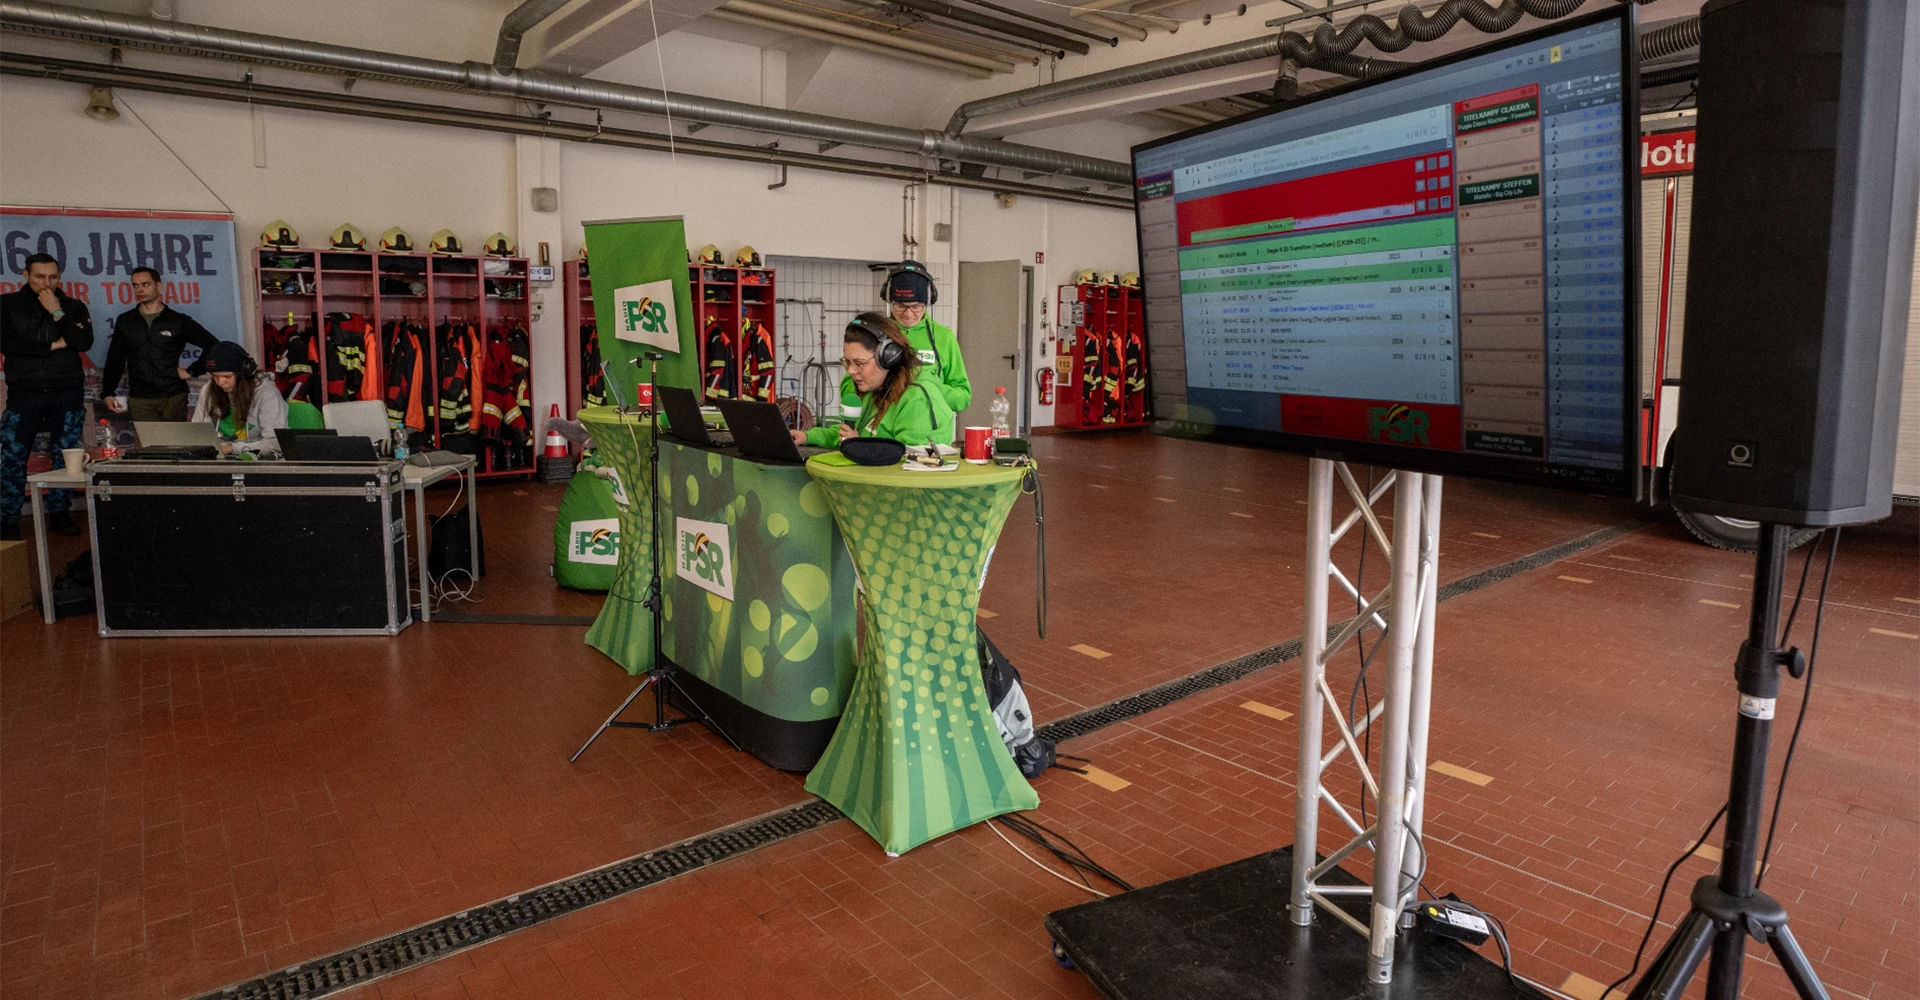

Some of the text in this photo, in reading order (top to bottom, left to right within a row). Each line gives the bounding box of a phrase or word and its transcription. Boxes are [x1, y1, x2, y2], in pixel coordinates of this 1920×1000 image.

[1463, 102, 1530, 122] TITELKAMPF CLAUDIA
[1465, 178, 1533, 194] TITELKAMPF STEFFEN
[0, 230, 217, 276] 60 JAHRE
[622, 297, 668, 334] RADIO PSR
[1059, 360, 1070, 368] 112
[1372, 403, 1430, 445] PSR
[685, 531, 726, 588] PSR
